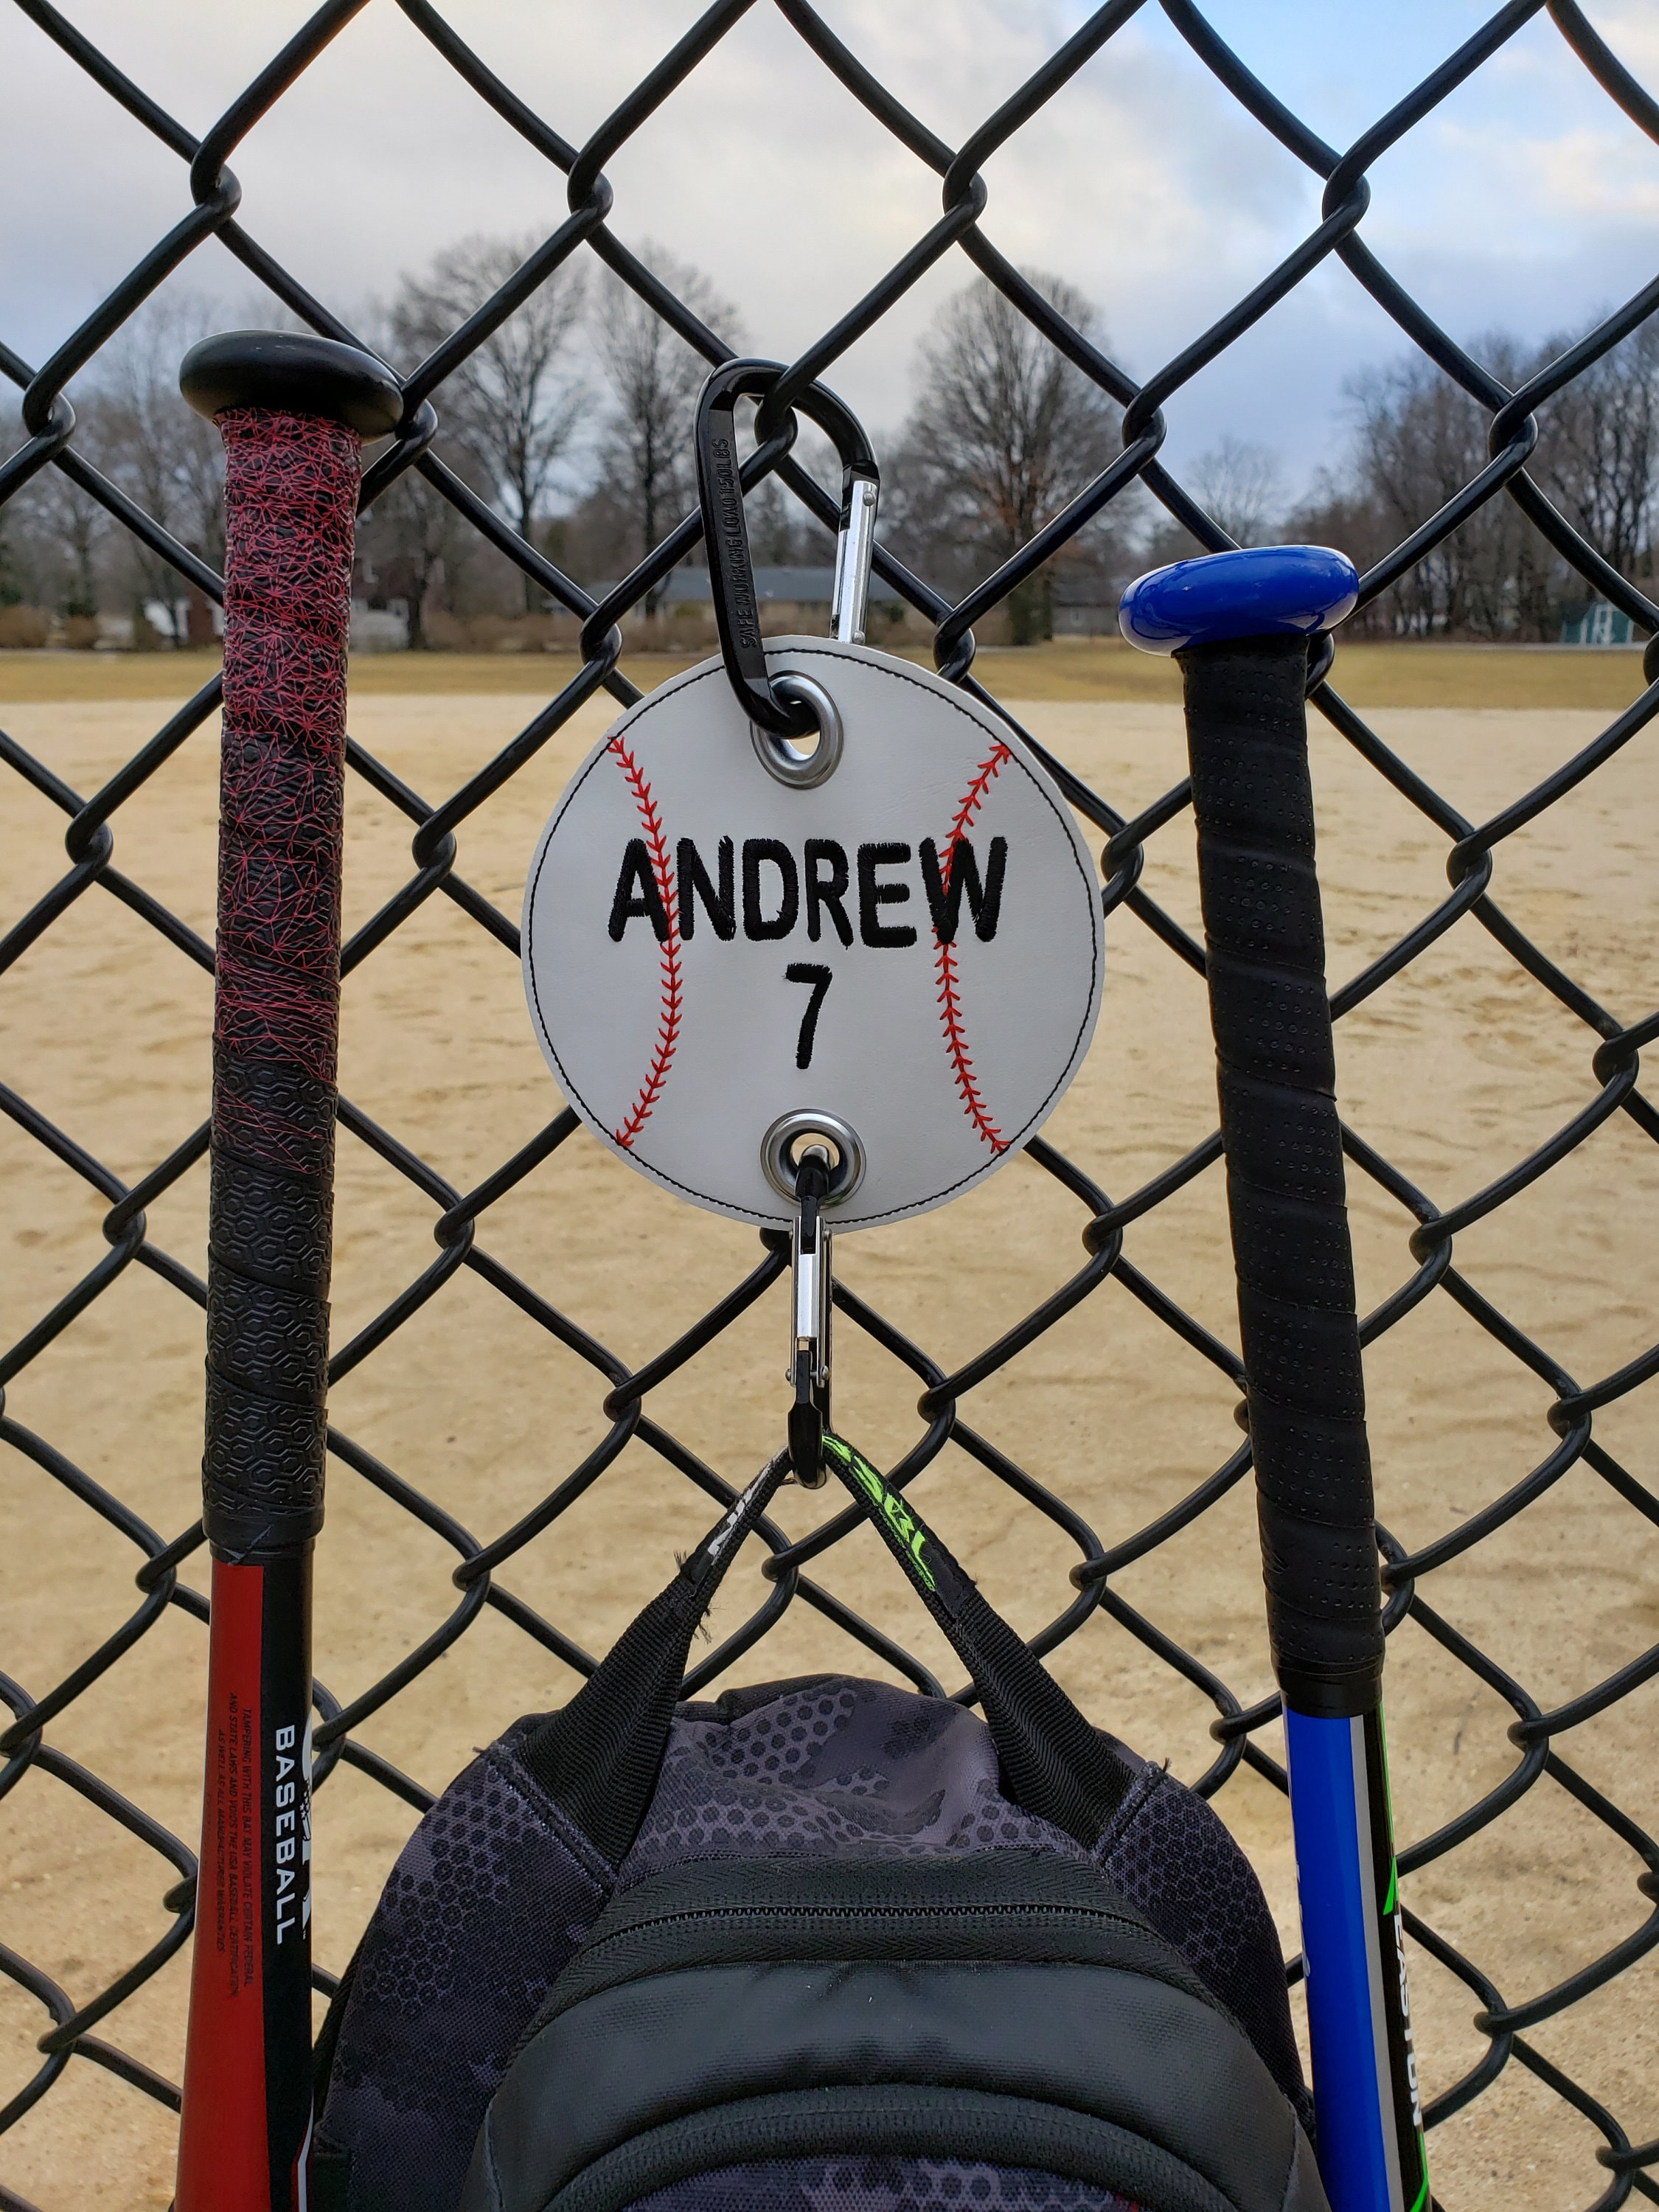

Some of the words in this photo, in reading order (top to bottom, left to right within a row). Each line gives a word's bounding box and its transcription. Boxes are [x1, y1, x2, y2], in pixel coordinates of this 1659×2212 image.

[719, 498, 742, 538] LOAD
[725, 539, 752, 605] WORKING
[737, 610, 757, 648] SAFE
[608, 835, 1008, 948] ANDREW
[785, 963, 832, 1069] 7
[229, 1692, 237, 1712] AND
[229, 1715, 237, 1745] STATE
[243, 1708, 251, 1762] TAMPERING
[229, 1747, 237, 1773] LAWS
[243, 1765, 251, 1789] WITH
[229, 1776, 237, 1796] AND
[243, 1792, 251, 1812] THIS
[229, 1799, 237, 1828] VOIDS
[243, 1815, 251, 1834] BAT
[229, 1831, 237, 1848] THE
[243, 1837, 252, 1857] MAY
[276, 1725, 296, 1945] BASEBALL
[229, 1851, 237, 1870] USA
[243, 1860, 252, 1899] VIOLATE
[229, 1873, 238, 1922] BASEBALL
[243, 1902, 253, 1941] CERTAIN
[229, 1925, 239, 1997] CERTIFICATION
[243, 1944, 254, 1987] FEDERAL
